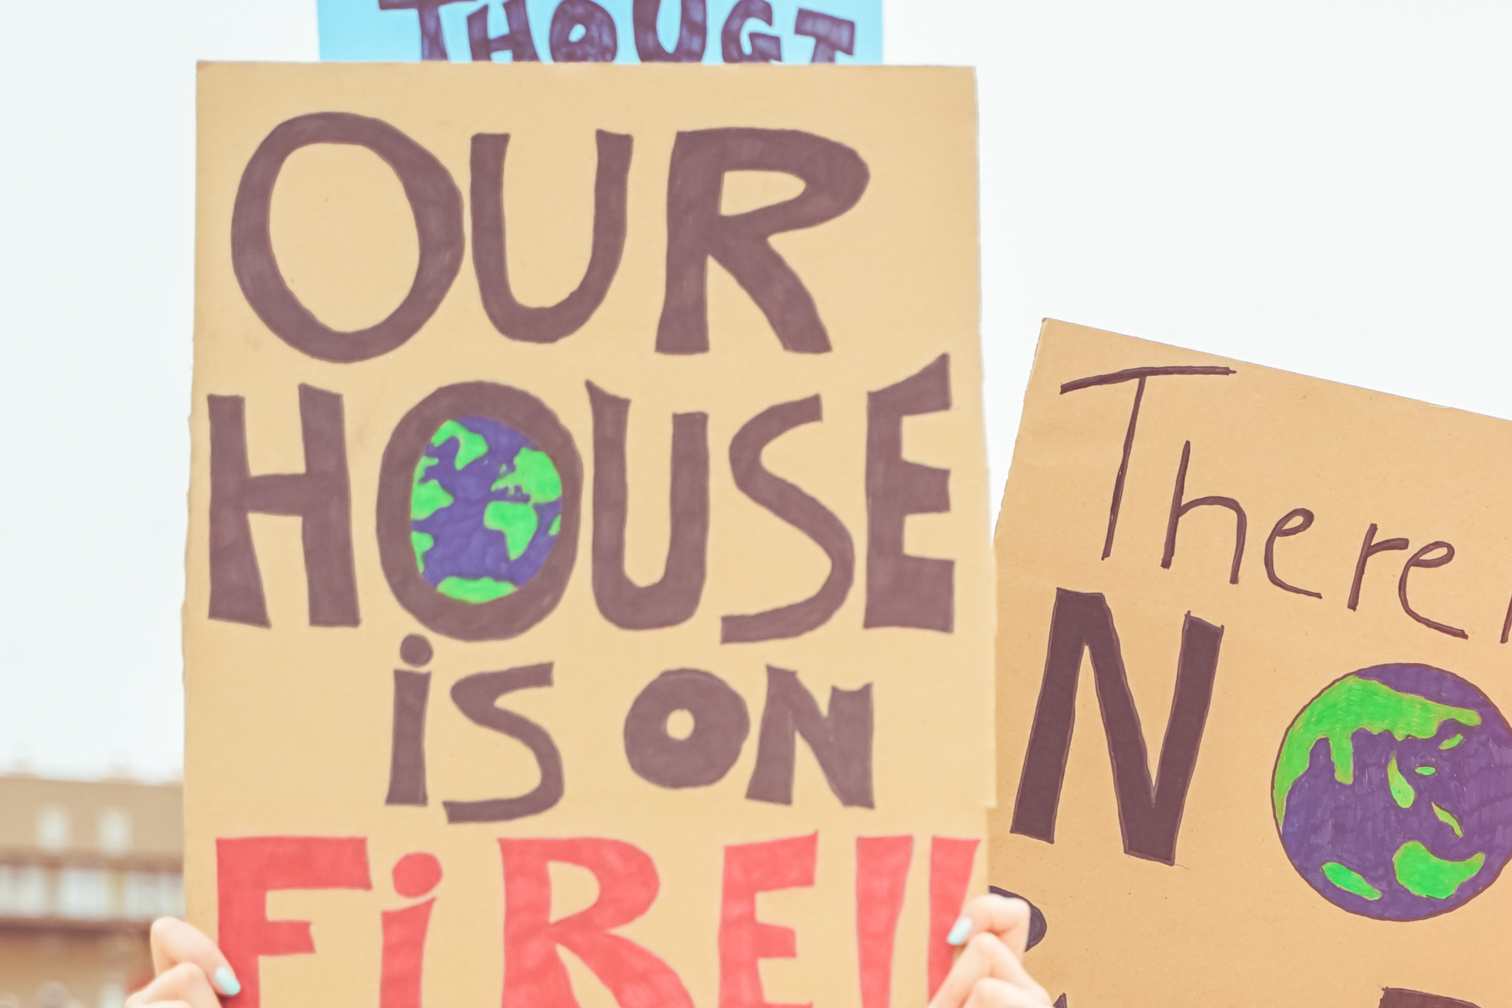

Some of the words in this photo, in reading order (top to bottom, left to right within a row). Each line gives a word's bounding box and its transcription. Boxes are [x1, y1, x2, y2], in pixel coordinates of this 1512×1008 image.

[230, 110, 871, 364] OUR
[206, 352, 955, 645] HOUSE
[1060, 365, 1469, 640] There
[622, 664, 876, 810] ON
